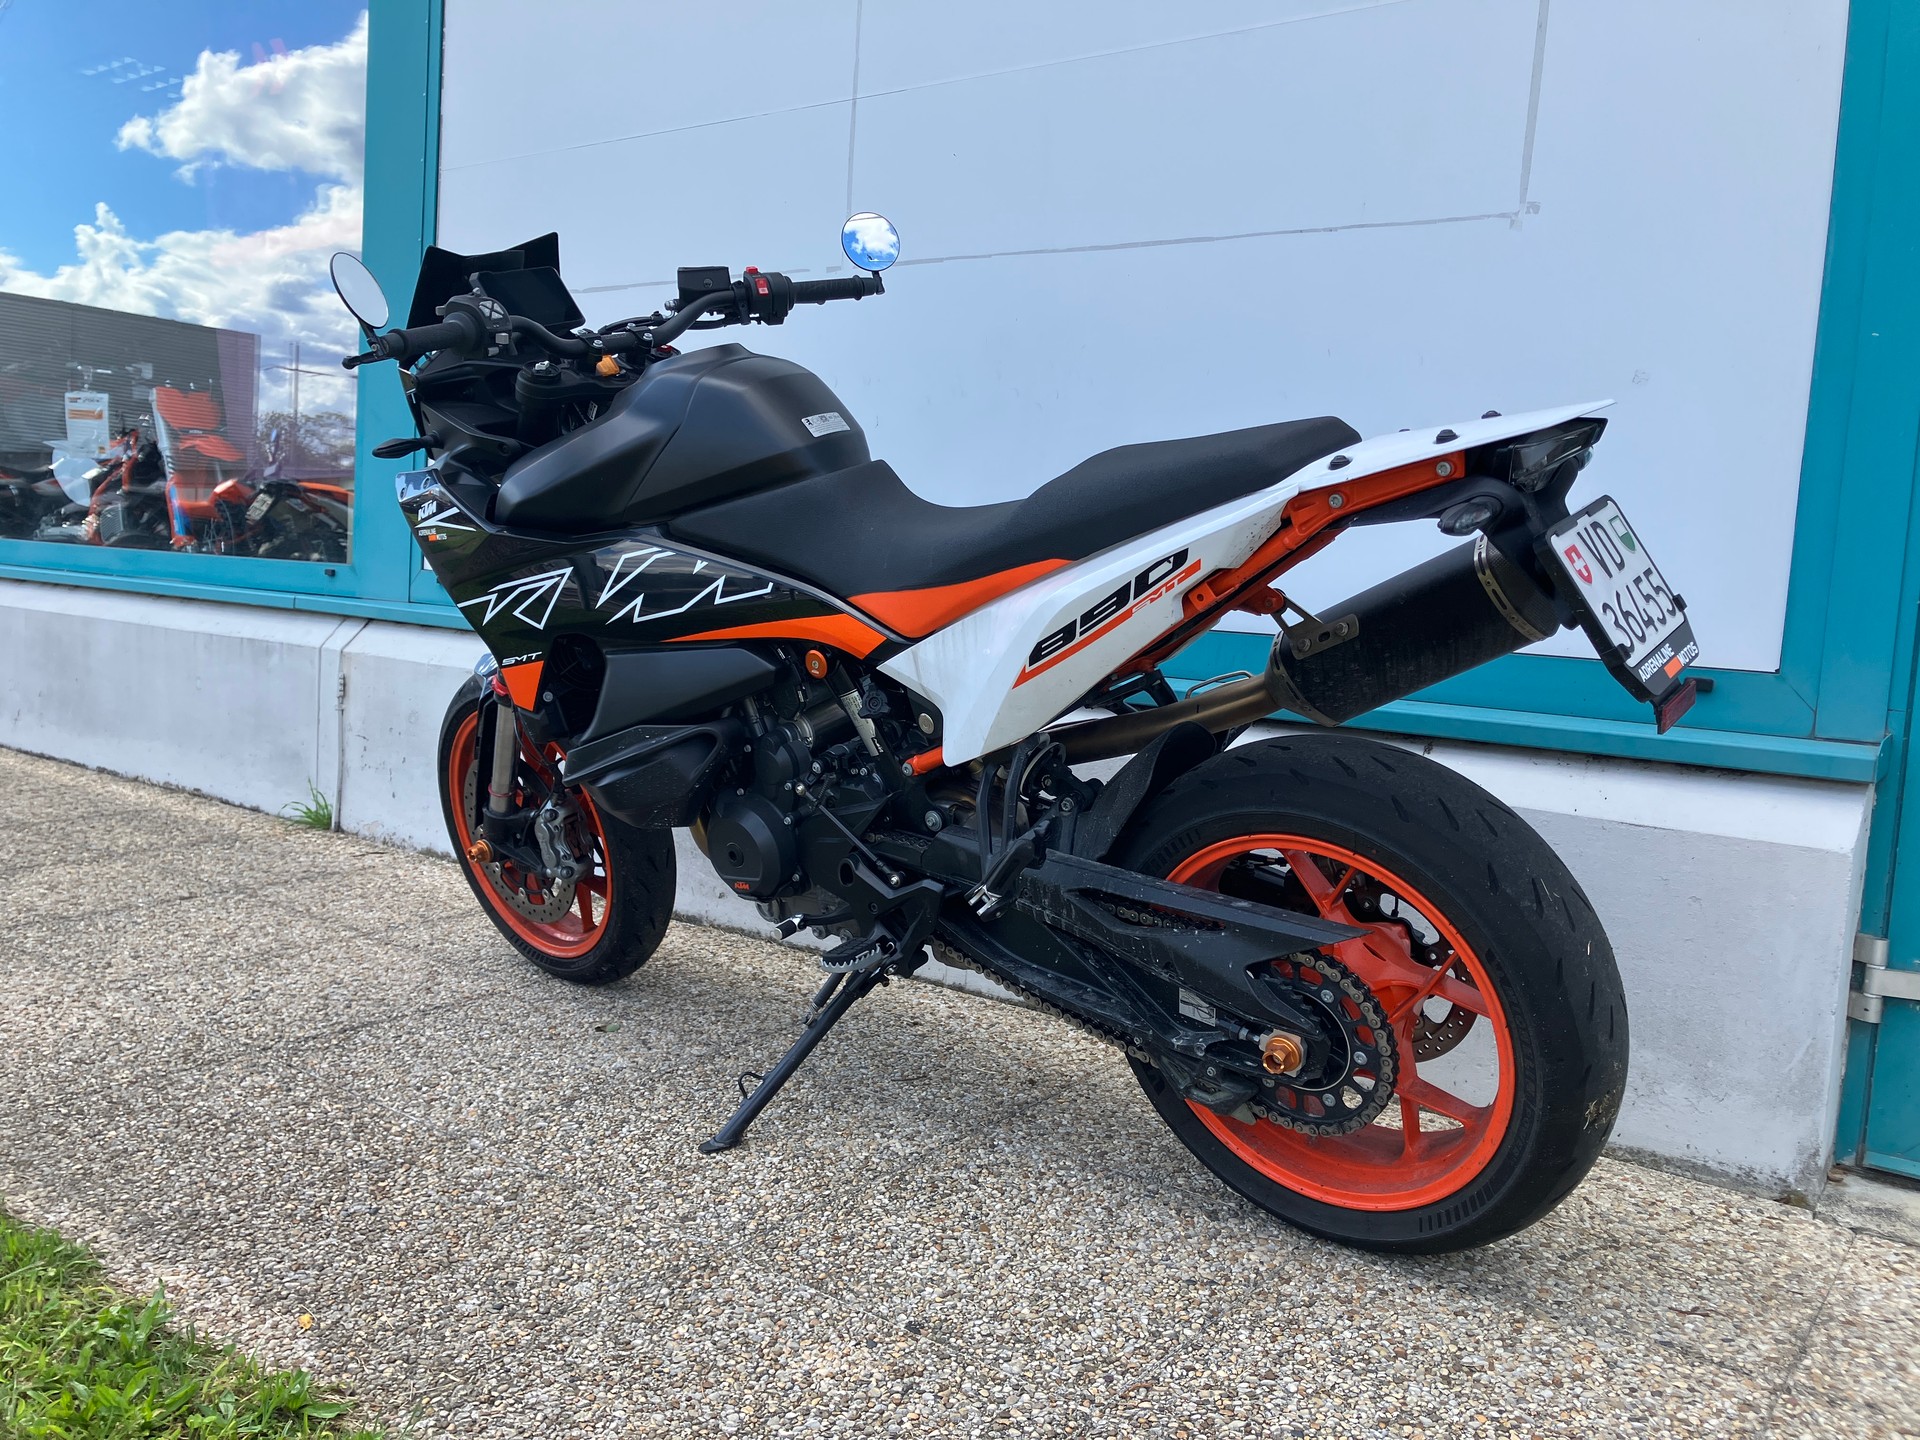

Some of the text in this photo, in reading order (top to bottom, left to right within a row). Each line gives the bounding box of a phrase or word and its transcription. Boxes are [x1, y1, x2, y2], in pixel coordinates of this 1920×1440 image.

[418, 500, 437, 521] KTM
[1577, 521, 1626, 579] VD
[1029, 547, 1189, 667] 890
[1132, 572, 1186, 614] SMT
[1602, 567, 1677, 653] 36455
[502, 651, 542, 666] SMT
[1638, 642, 1675, 682] ADRENALINE
[1676, 641, 1699, 667] MOTOS
[735, 881, 750, 890] KTM
